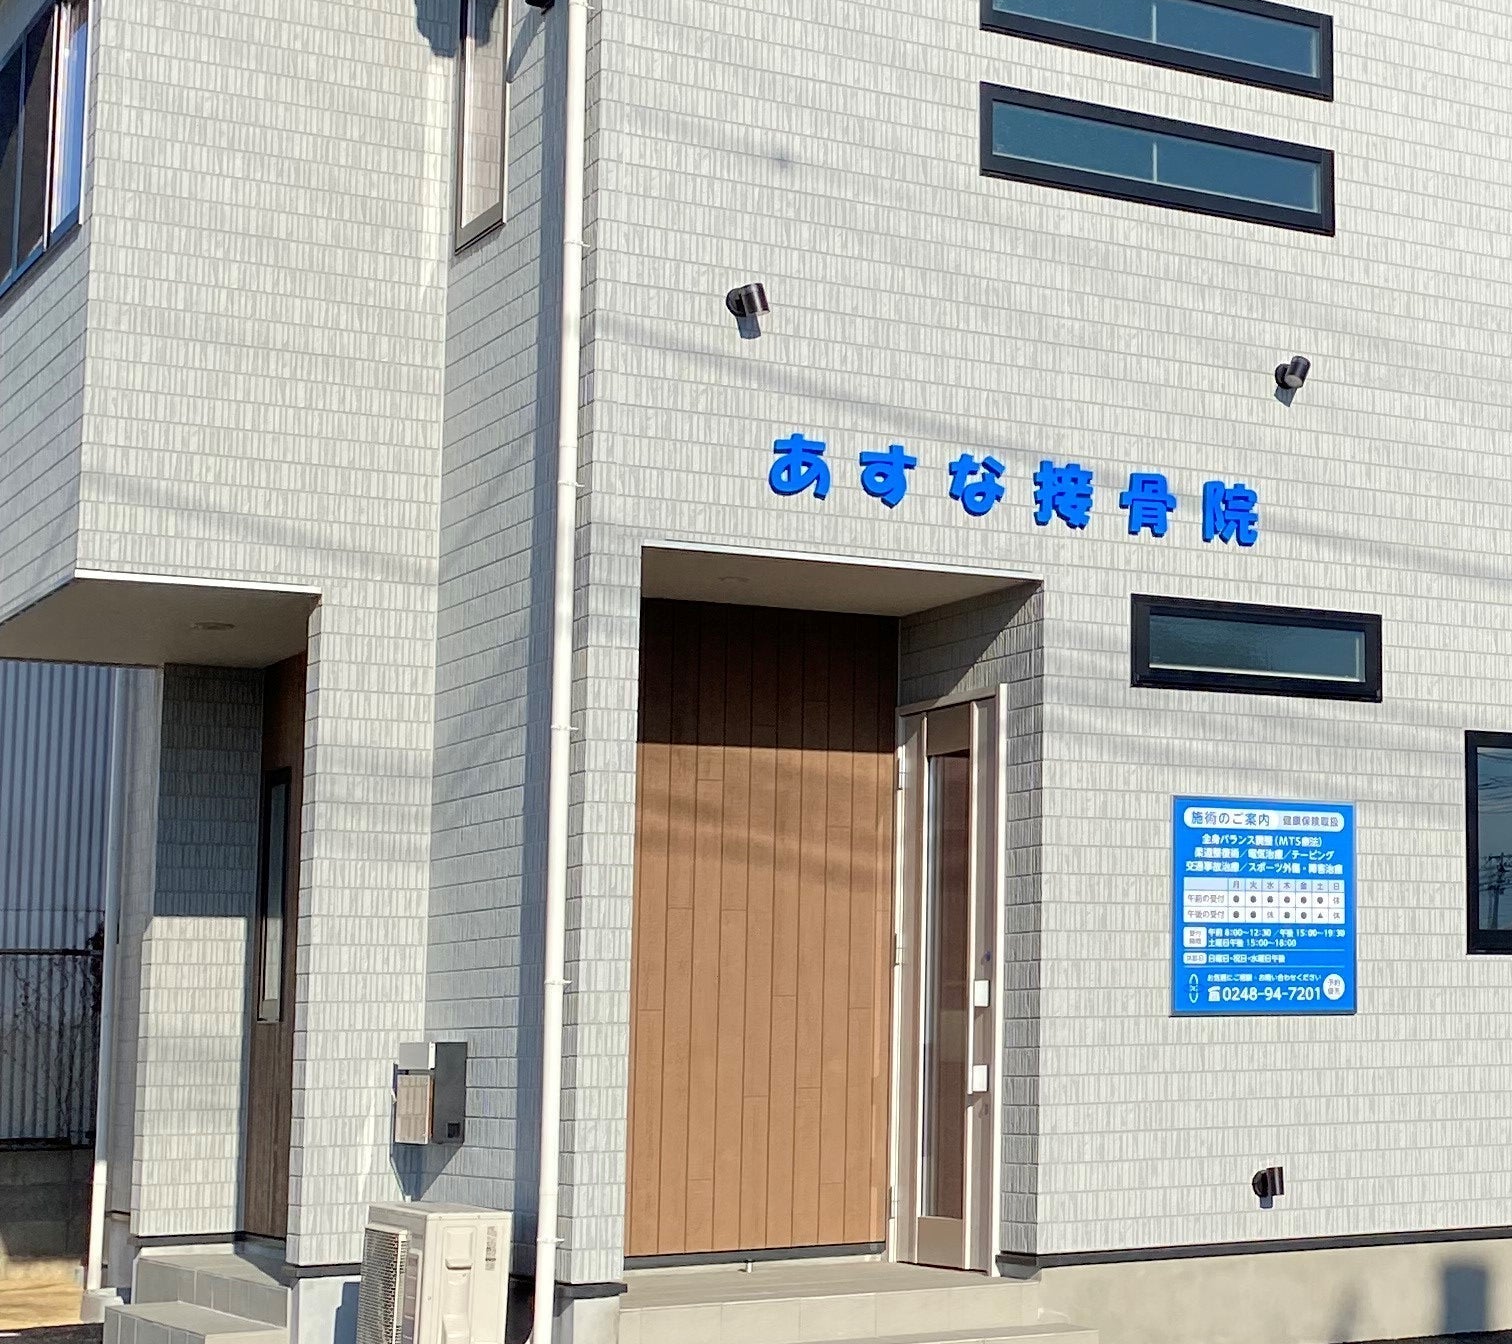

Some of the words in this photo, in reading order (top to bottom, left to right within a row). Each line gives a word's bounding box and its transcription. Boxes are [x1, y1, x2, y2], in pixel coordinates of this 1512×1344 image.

[768, 432, 1260, 547] あすな接骨院
[1191, 811, 1270, 827] 施術のご案内
[1222, 986, 1321, 1002] 0248-94-7201
